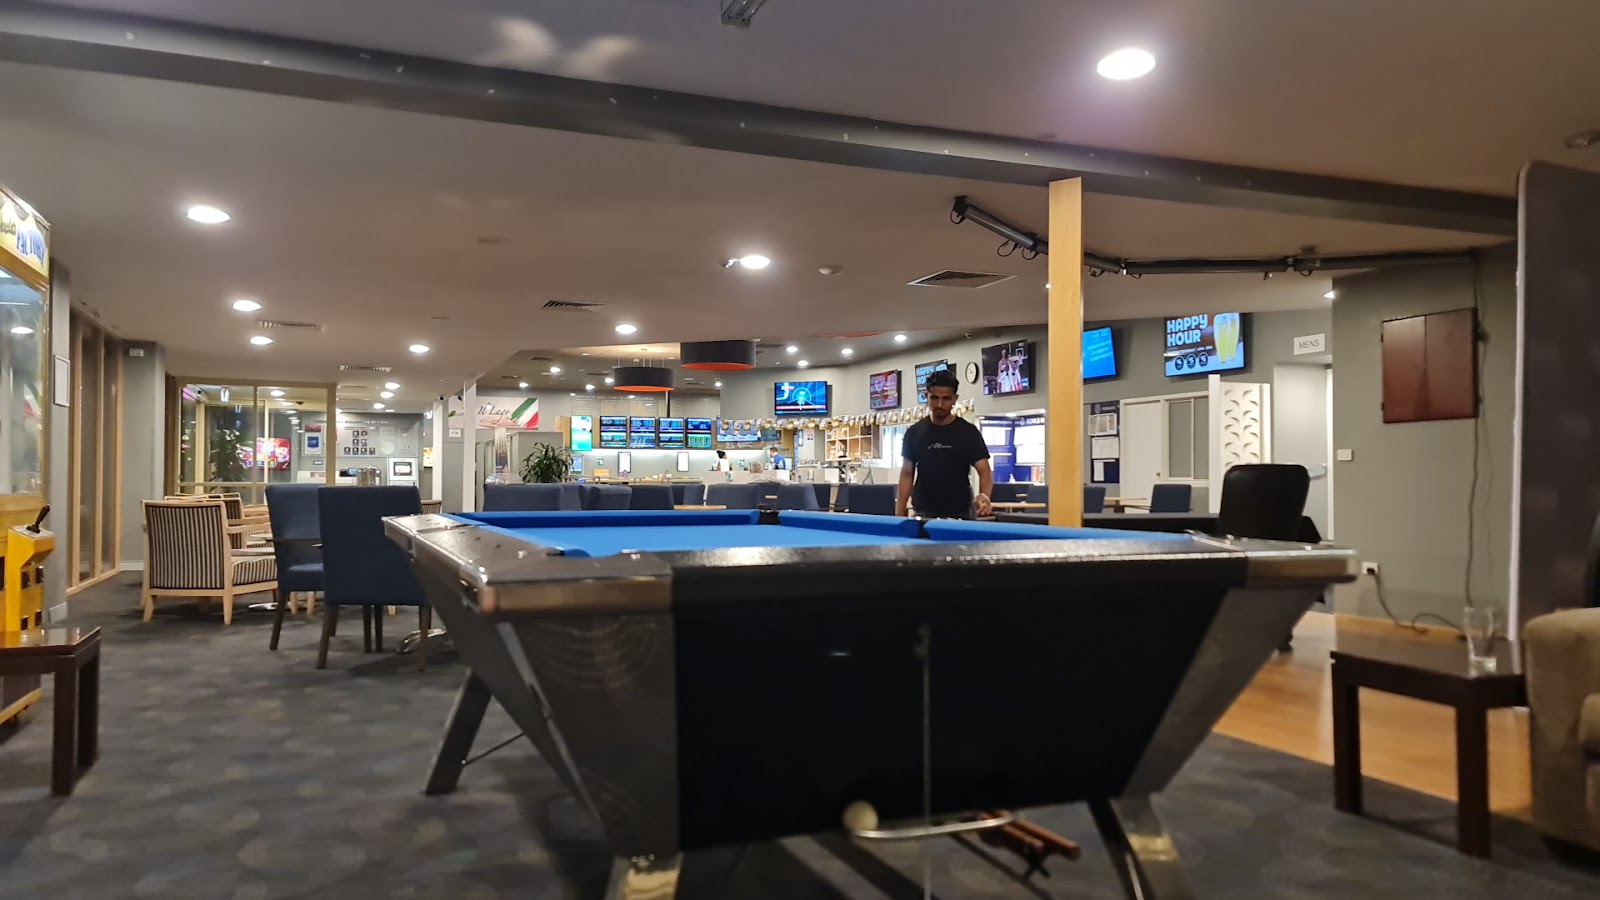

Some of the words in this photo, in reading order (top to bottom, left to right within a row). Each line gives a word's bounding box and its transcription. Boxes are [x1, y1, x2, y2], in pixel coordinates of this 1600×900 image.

[1167, 314, 1208, 333] HAPPY
[1167, 330, 1201, 347] HOUR
[1299, 339, 1320, 349] MENS
[489, 405, 510, 424] Lago
